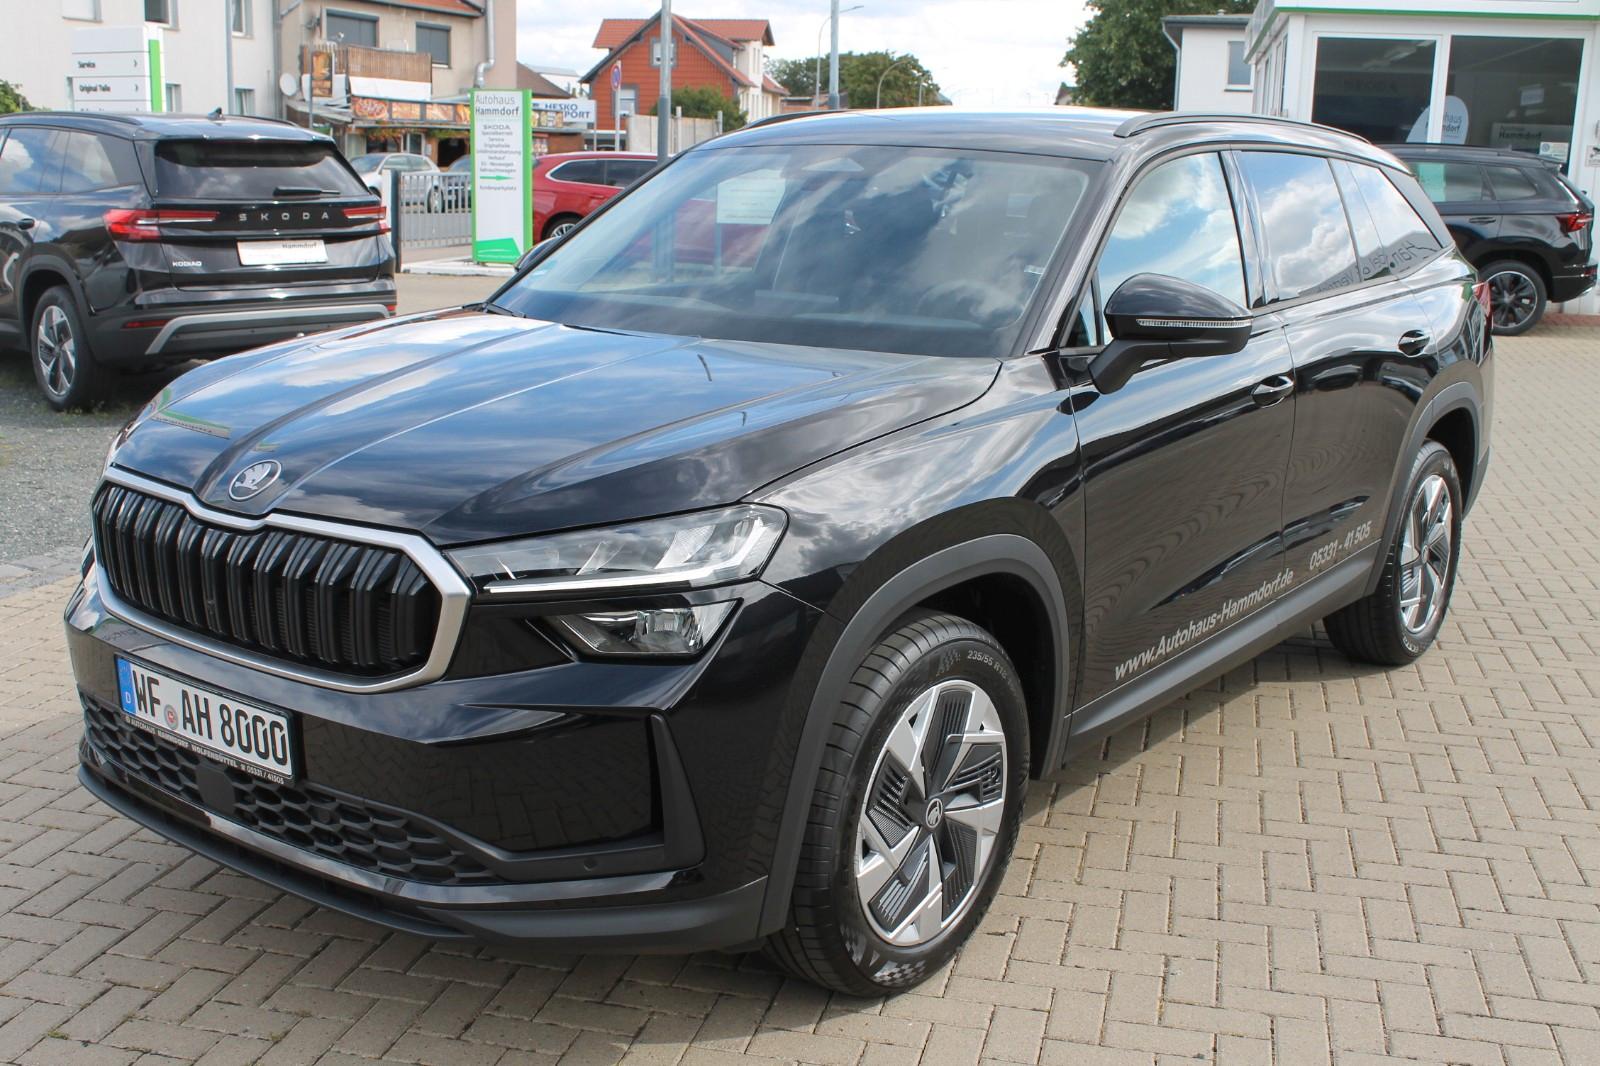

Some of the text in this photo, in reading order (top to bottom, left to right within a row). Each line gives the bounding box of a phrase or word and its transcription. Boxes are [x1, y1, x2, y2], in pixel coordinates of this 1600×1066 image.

[475, 95, 516, 105] Autohaus
[475, 106, 519, 116] Hammdorf
[1115, 568, 1294, 681] www.Autohaus-Hammdorf.de
[1309, 539, 1338, 571] 05331
[967, 650, 993, 666] 235/55
[132, 670, 288, 767] WF AH 8000
